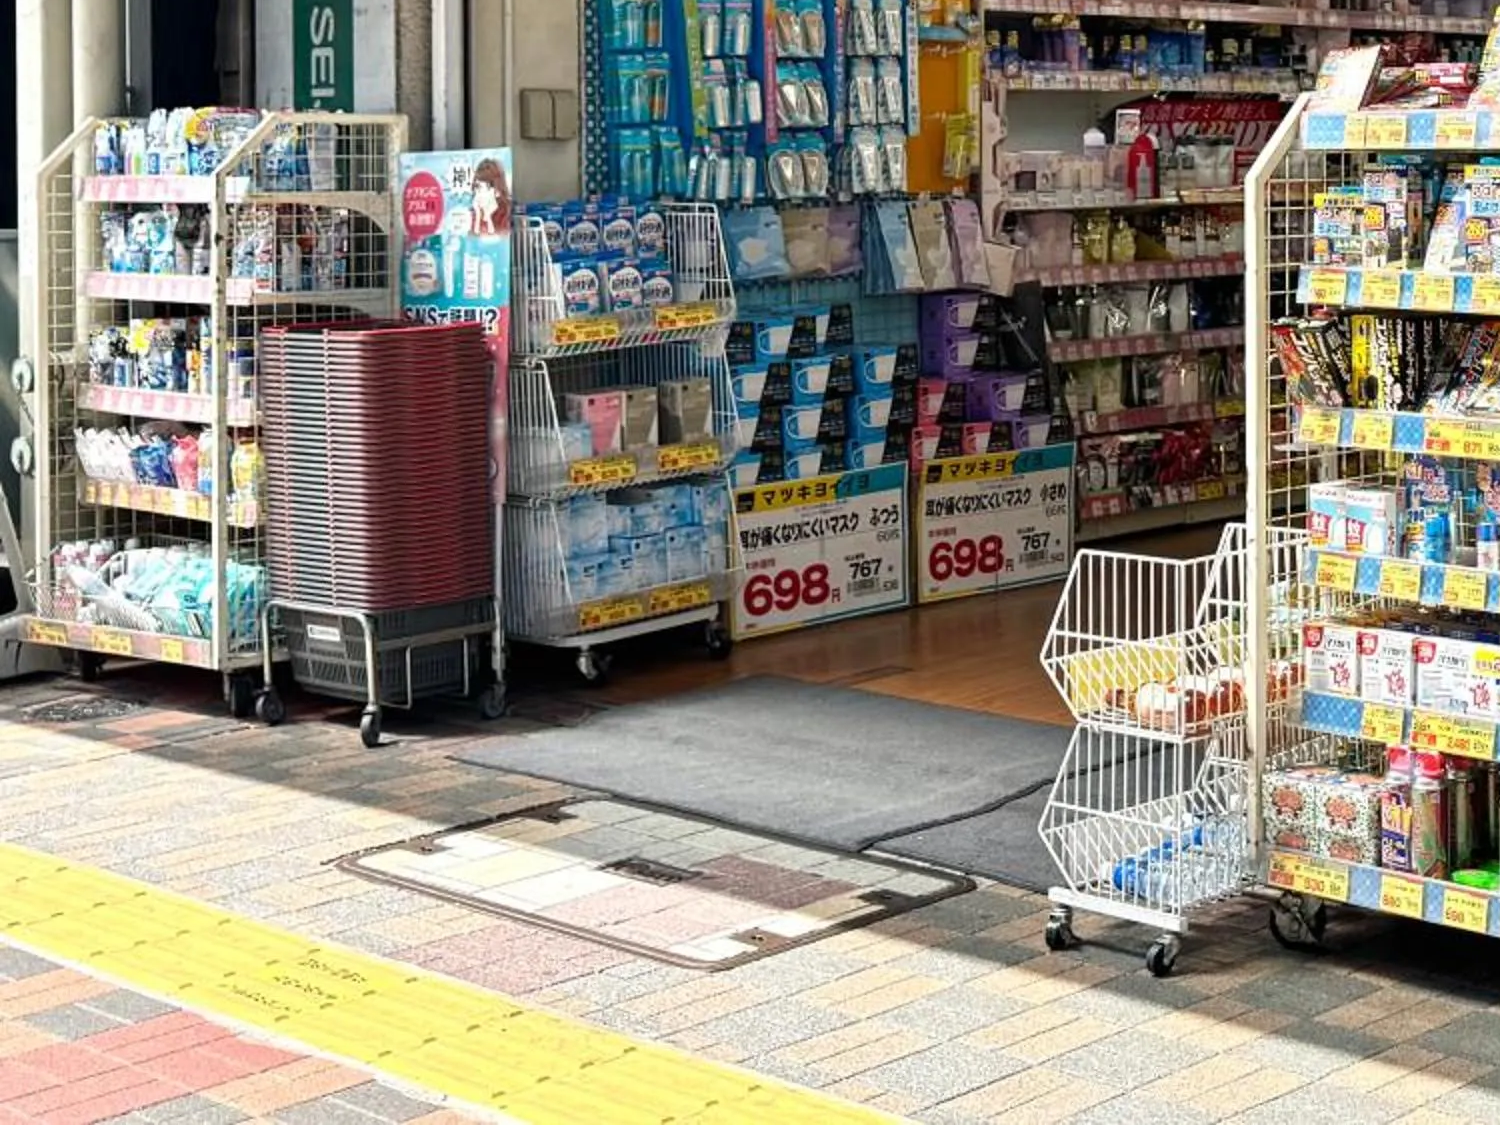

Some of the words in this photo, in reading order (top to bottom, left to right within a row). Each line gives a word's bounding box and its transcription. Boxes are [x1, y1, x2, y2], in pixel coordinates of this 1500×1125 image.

[926, 488, 1031, 517] 耳が痛くなりにくいマスク
[740, 513, 860, 550] 耳が痛くなりにくいマスク
[869, 504, 899, 526] ふつう
[1021, 531, 1051, 552] 767
[849, 558, 883, 579] 767
[928, 535, 1004, 581] 698
[744, 563, 829, 617] 698
